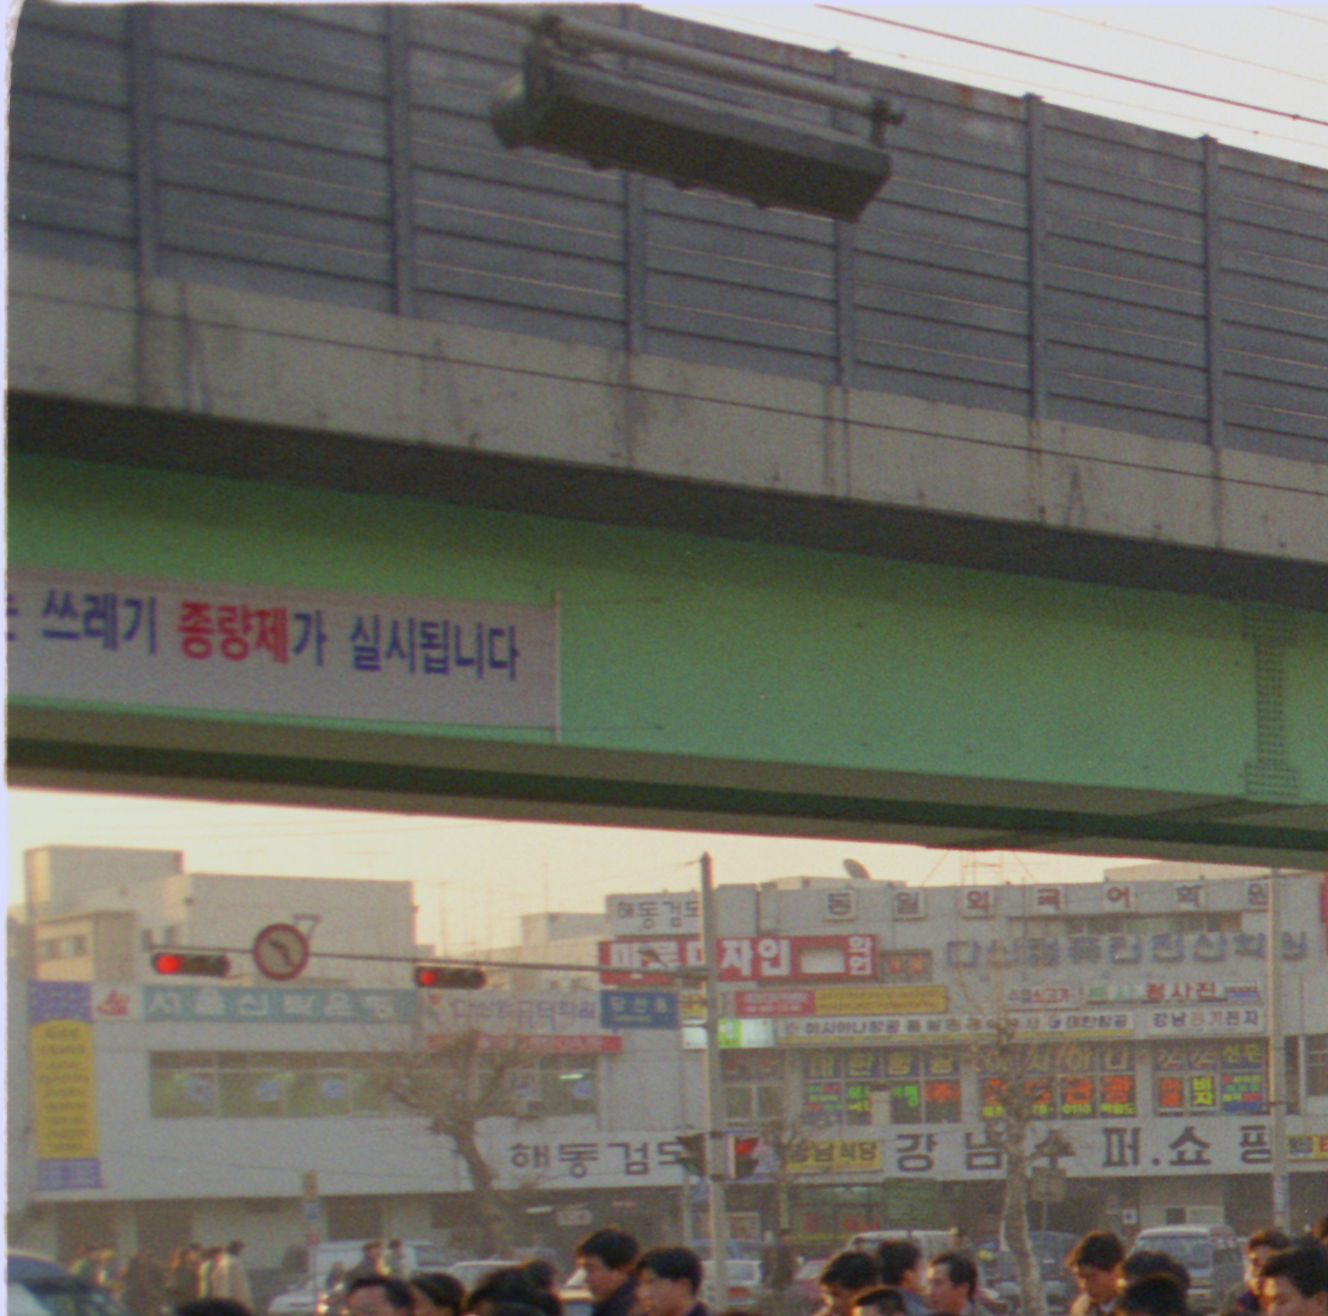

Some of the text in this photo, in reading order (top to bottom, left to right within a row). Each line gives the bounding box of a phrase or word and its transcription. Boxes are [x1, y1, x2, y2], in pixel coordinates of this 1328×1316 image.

[42, 587, 158, 655] 쓰레기
[177, 600, 327, 668] 종량제가
[349, 614, 520, 681] 실시됩니다
[510, 1141, 685, 1179] 해동검도
